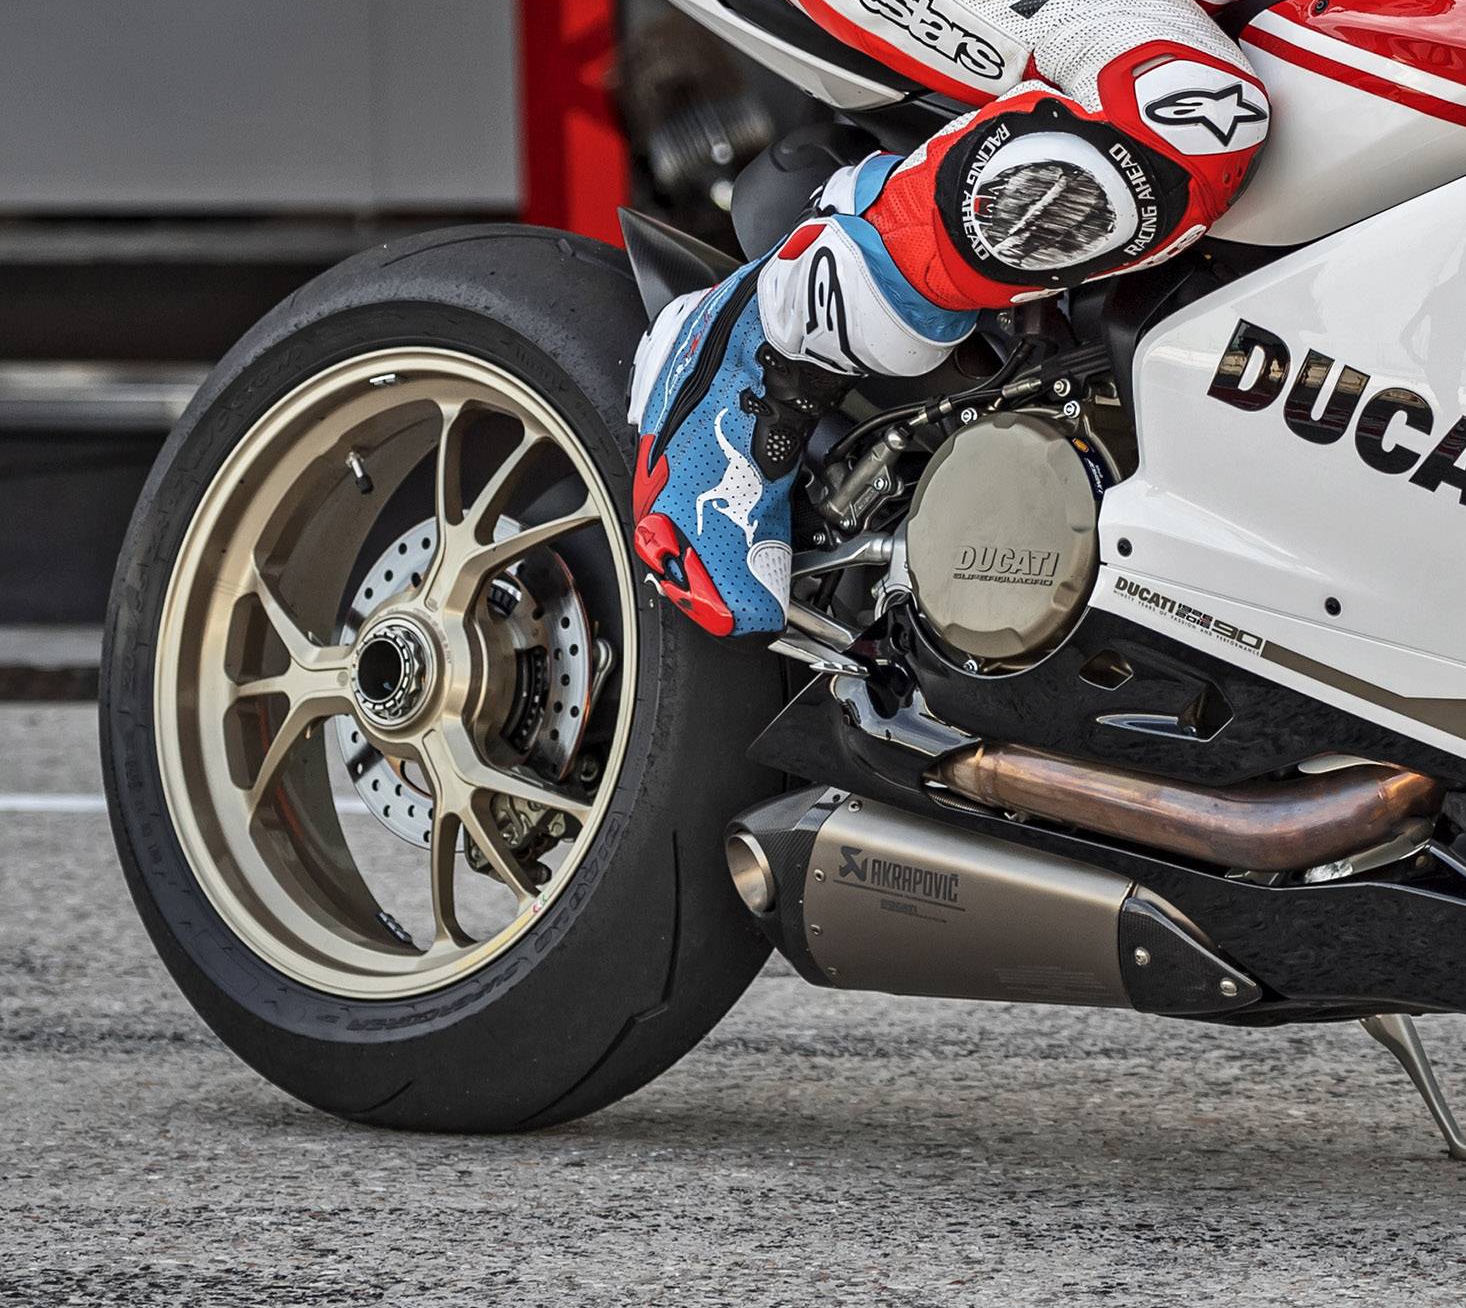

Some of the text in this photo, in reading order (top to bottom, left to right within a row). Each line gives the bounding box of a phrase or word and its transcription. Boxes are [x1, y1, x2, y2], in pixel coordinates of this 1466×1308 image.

[961, 123, 1012, 261] RACING AHEAD
[1109, 143, 1157, 257] RACING AHEAD
[953, 545, 1060, 578] DUCATI
[1114, 576, 1177, 614] DUCATI
[1212, 619, 1264, 650] 90
